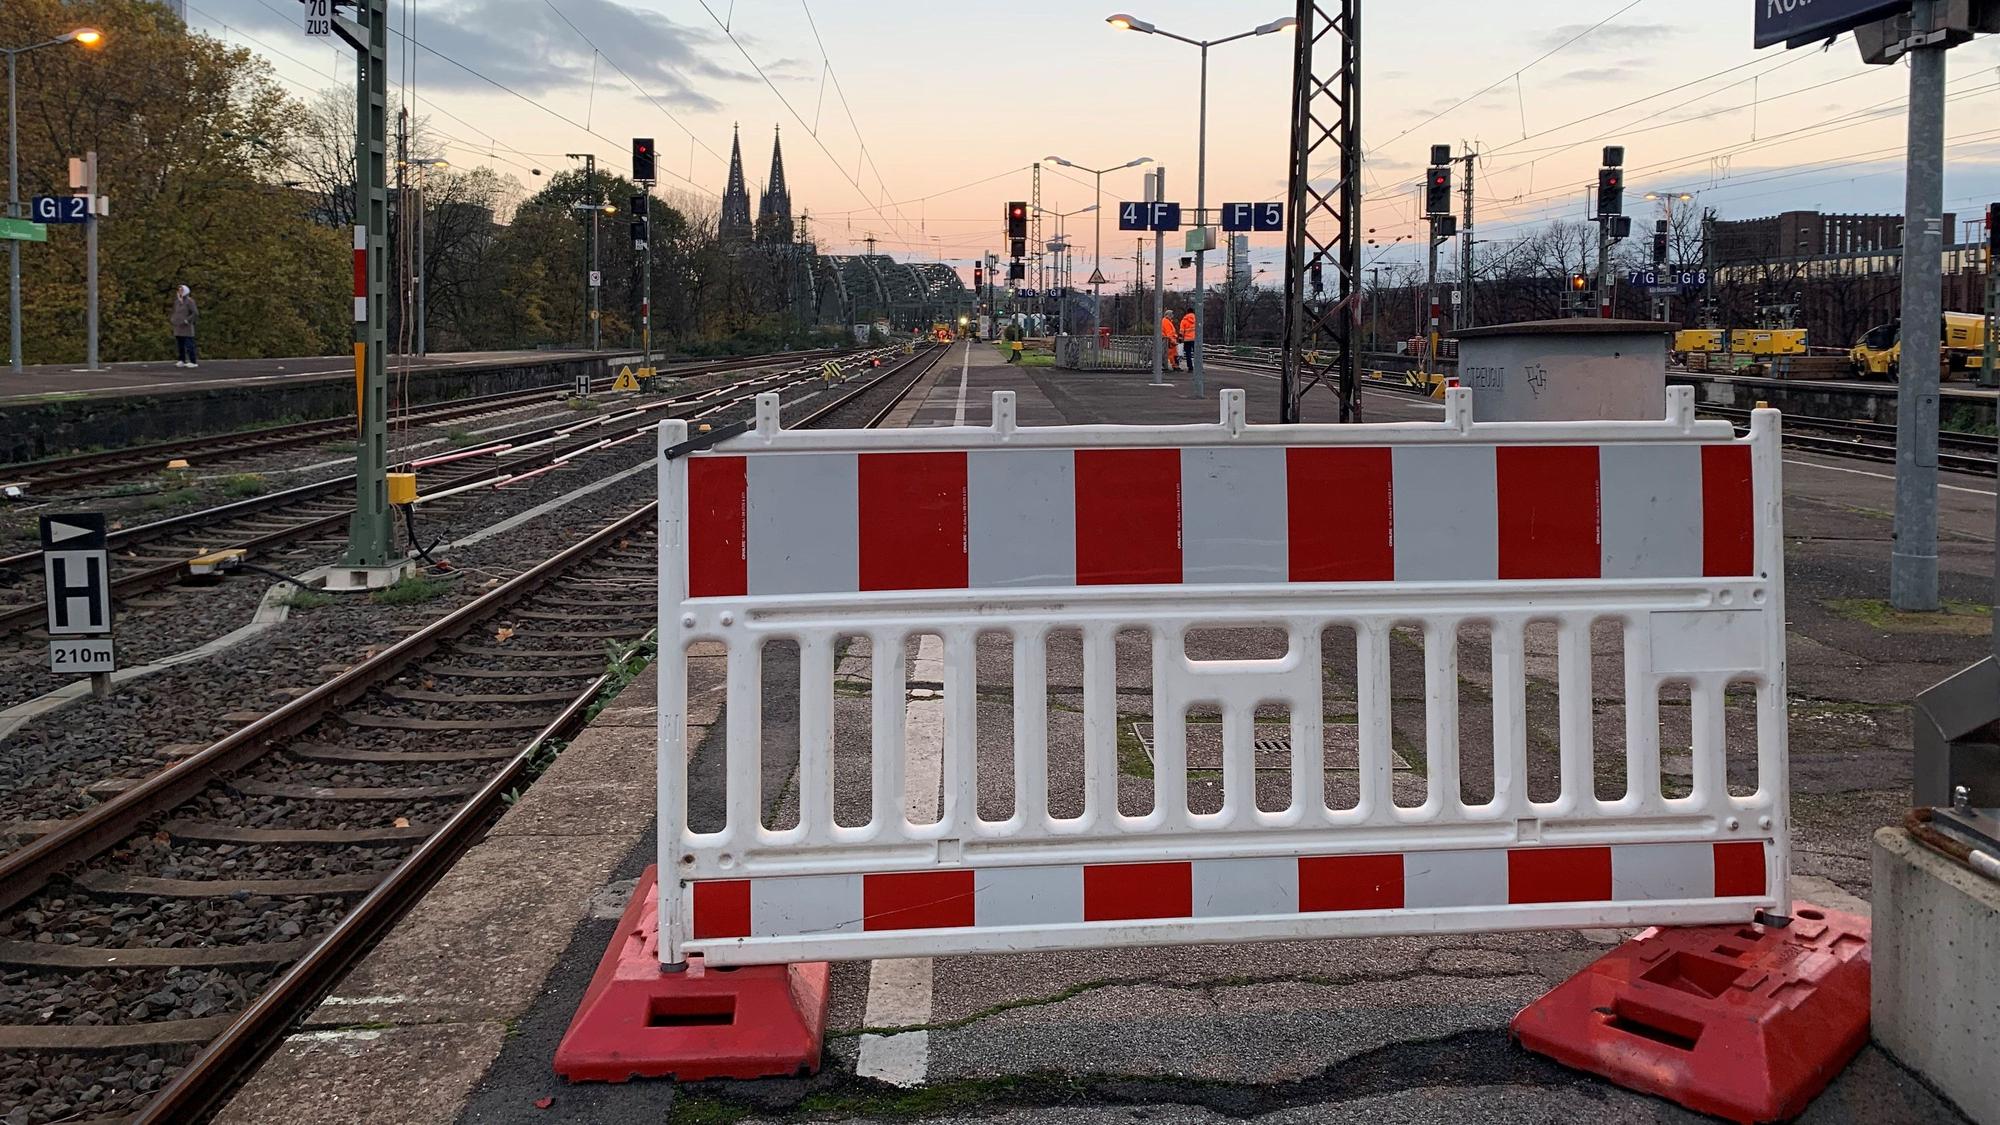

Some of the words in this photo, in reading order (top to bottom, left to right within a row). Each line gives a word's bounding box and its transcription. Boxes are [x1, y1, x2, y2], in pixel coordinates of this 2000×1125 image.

[310, 0, 326, 16] 70
[307, 20, 328, 34] ZU3
[40, 197, 56, 218] G
[71, 197, 84, 217] 2
[1123, 203, 1137, 224] 4
[1154, 204, 1168, 224] F
[1234, 204, 1248, 225] F
[1265, 204, 1280, 225] 5
[1631, 272, 1638, 284] 7
[1645, 272, 1655, 284] G
[1682, 272, 1691, 284] G
[1698, 272, 1706, 284] 8
[577, 377, 589, 394] H
[623, 374, 629, 388] 3
[52, 557, 103, 627] H
[55, 648, 111, 664] 210m
